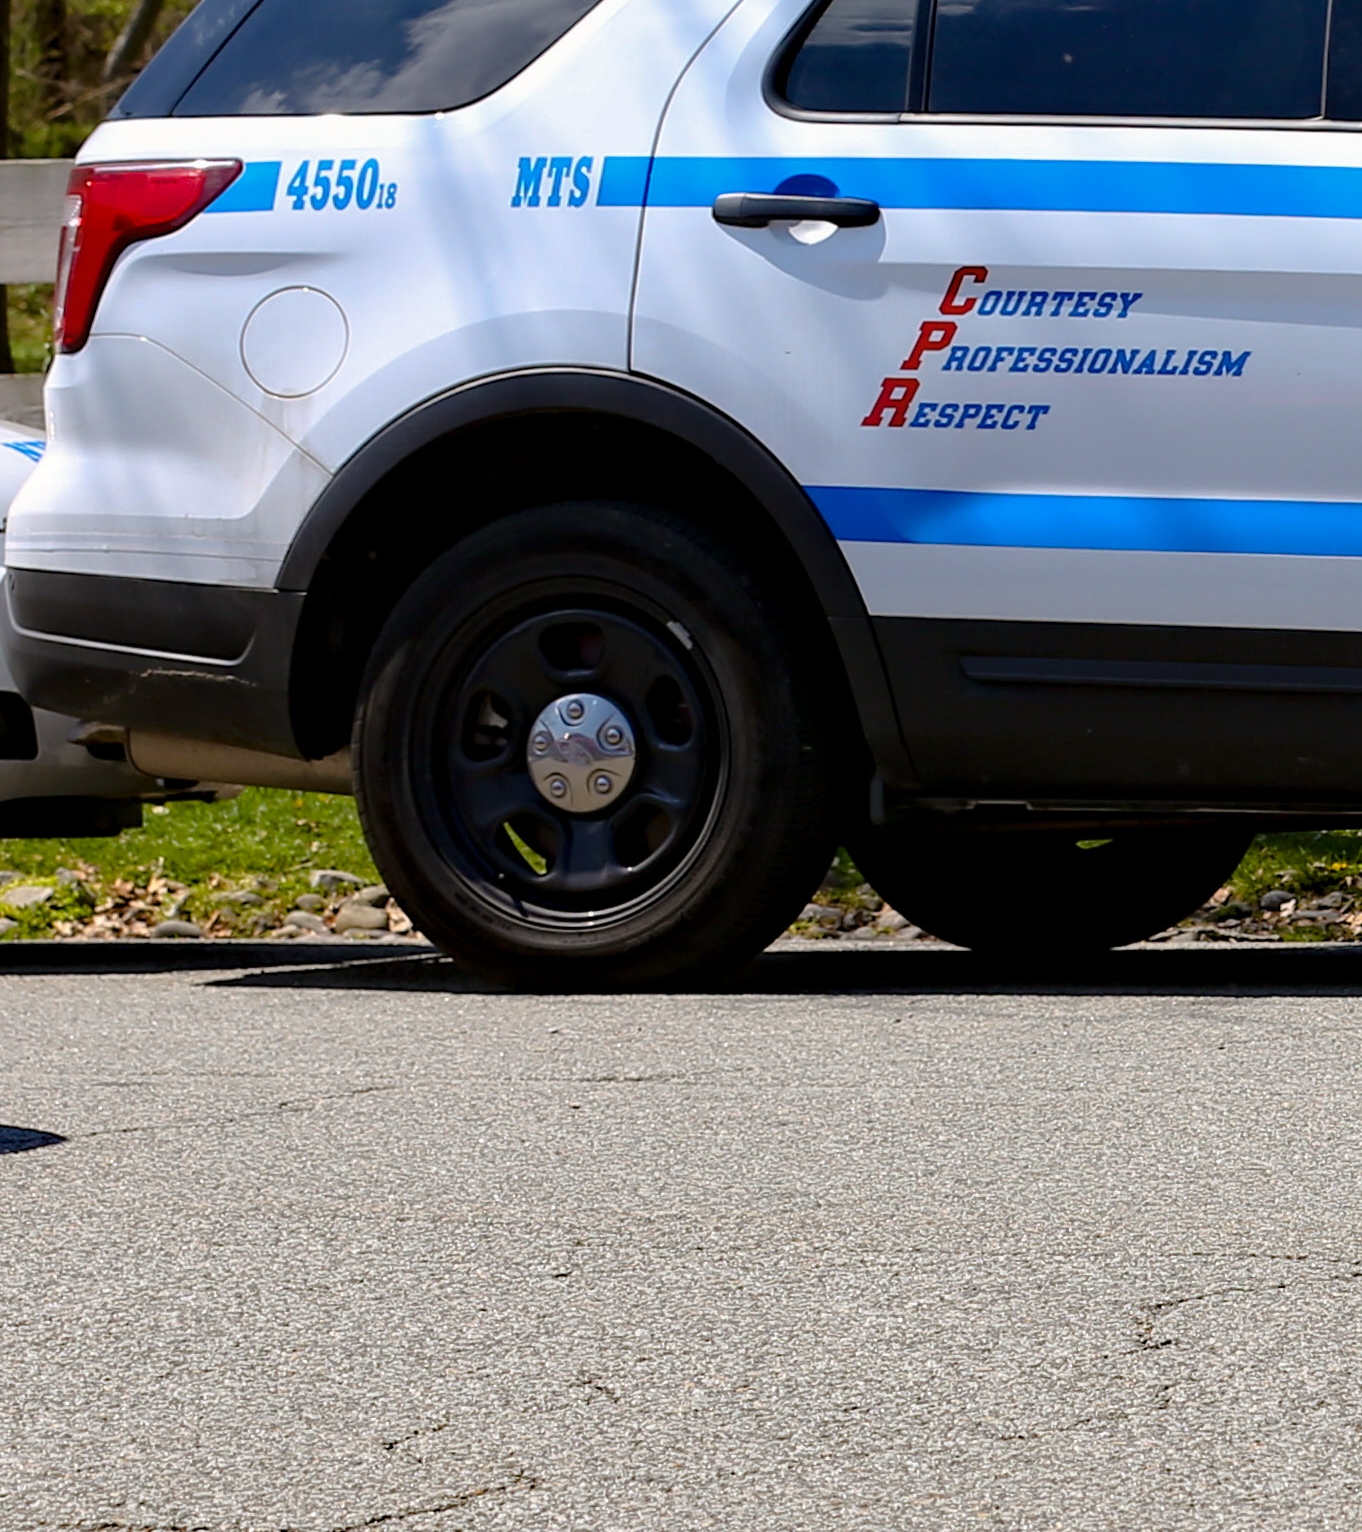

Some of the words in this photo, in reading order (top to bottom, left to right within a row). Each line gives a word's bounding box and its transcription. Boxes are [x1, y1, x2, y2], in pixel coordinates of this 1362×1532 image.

[510, 155, 594, 209] MTS
[939, 266, 1143, 318] COURTESY
[900, 321, 1252, 377] PROFESSIONALISM
[861, 377, 1051, 431] RESPECT
